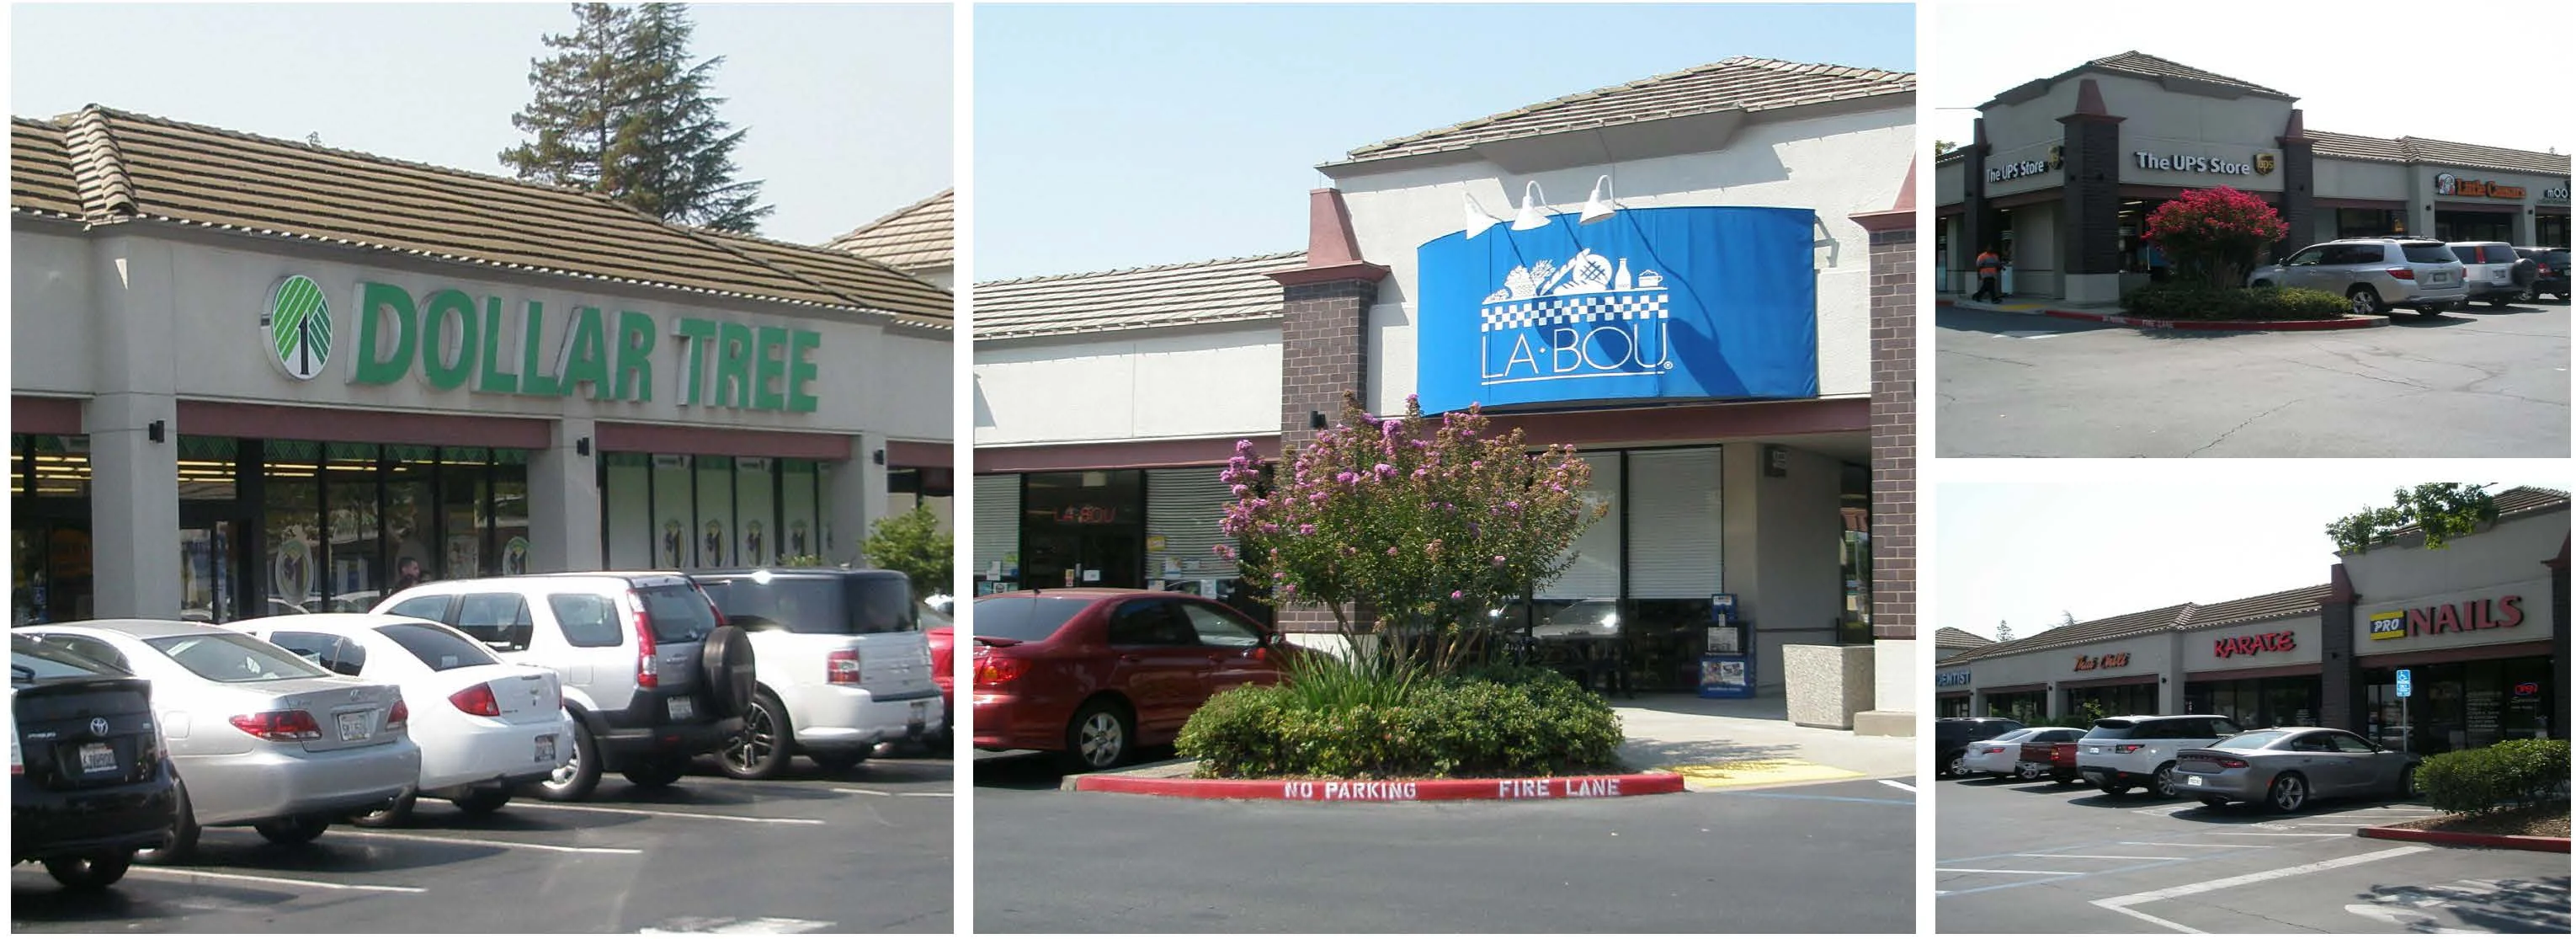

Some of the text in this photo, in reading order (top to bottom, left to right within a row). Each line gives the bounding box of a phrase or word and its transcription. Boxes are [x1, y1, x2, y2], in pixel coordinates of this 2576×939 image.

[1987, 168, 2001, 183] The
[2002, 163, 2019, 179] UPS
[2020, 160, 2044, 176] Store
[2137, 152, 2250, 175] The UPS Store
[349, 281, 822, 413] DOLLAR TREE
[2374, 595, 2523, 638] PRO NAILS
[2214, 631, 2295, 659] KARATE
[1284, 782, 1417, 799] NO PARKING
[1498, 778, 1621, 798] FIRE LANE
